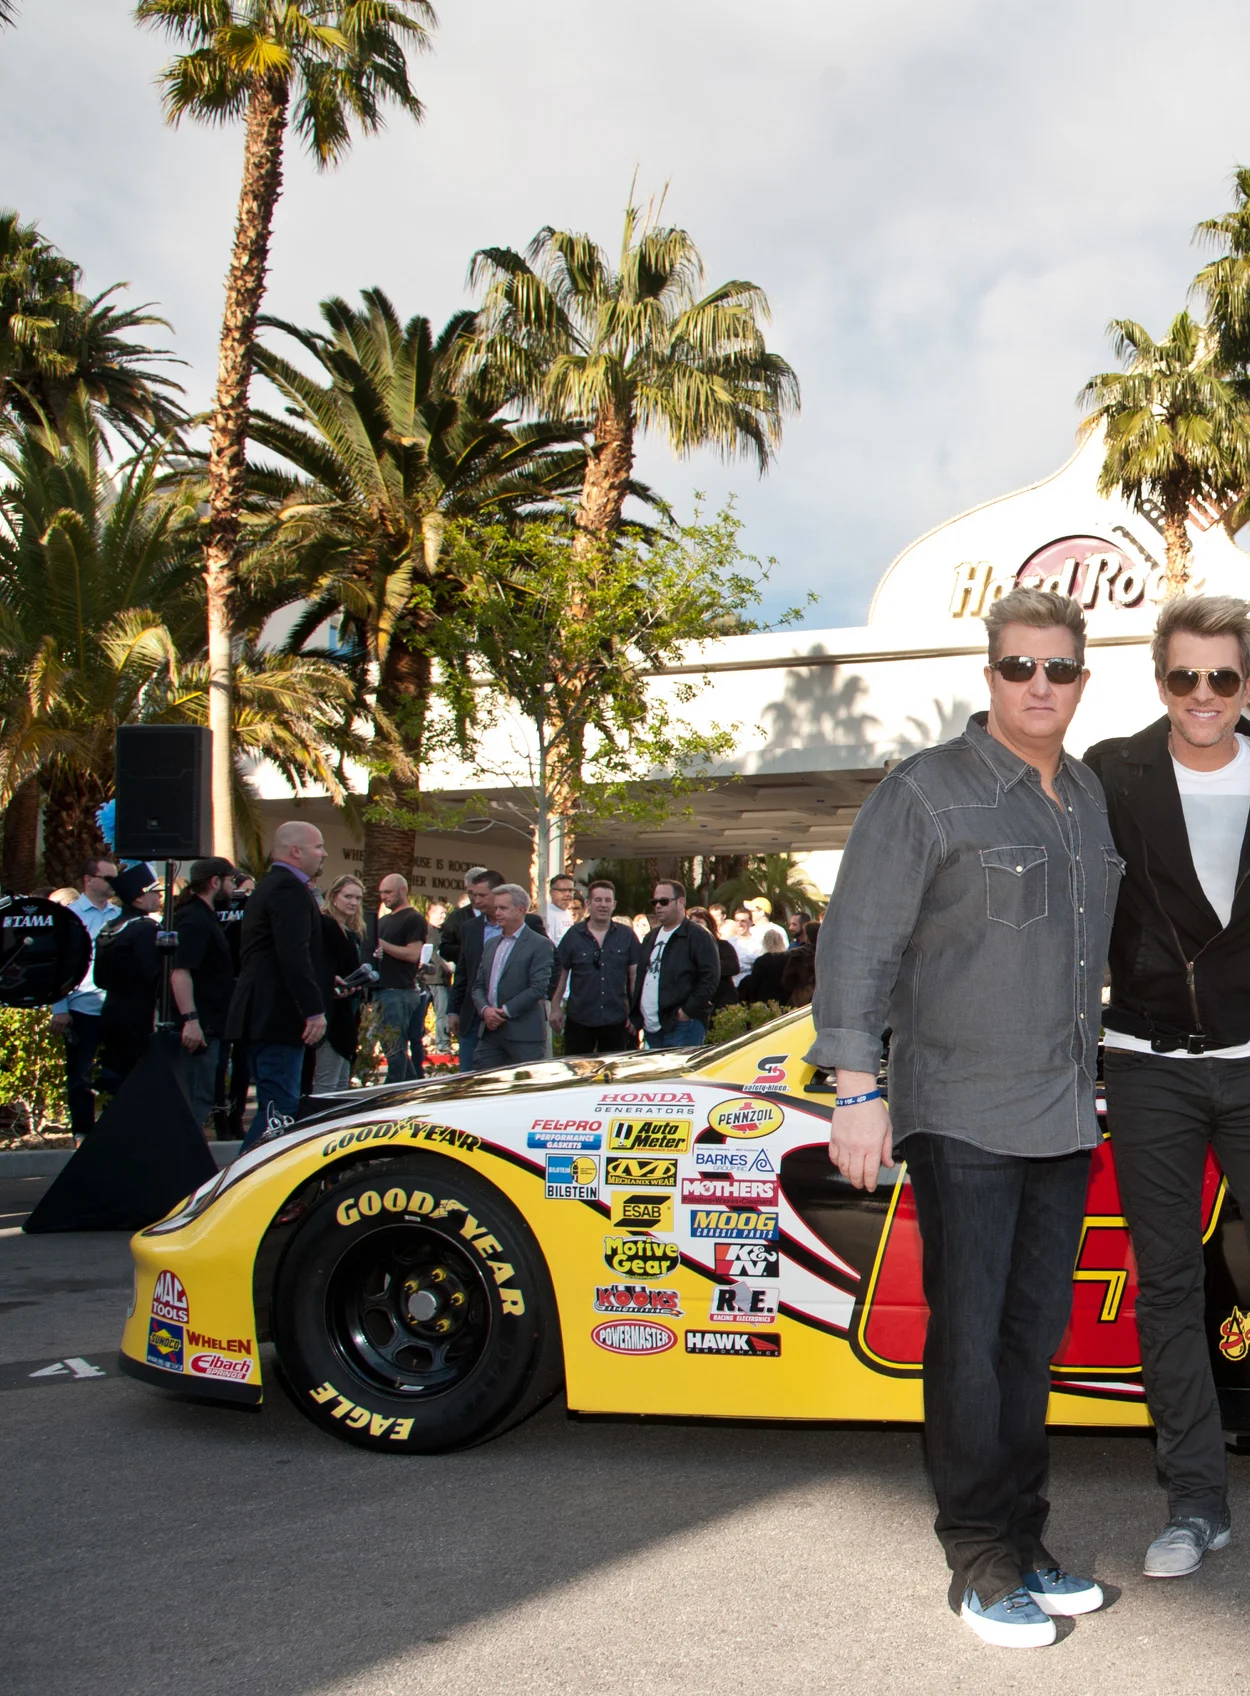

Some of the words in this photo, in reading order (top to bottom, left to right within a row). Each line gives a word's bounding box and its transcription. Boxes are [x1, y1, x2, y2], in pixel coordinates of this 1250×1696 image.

[12, 914, 54, 928] TAMA
[600, 1092, 696, 1103] HONDA
[594, 1106, 695, 1115] GENERATORS
[717, 1108, 774, 1126] PENNZOIL
[531, 1119, 603, 1132] FEL-PRO
[637, 1121, 680, 1135] Auto
[535, 1133, 595, 1142] PERFORMANCE
[634, 1135, 686, 1149] Meter
[546, 1142, 582, 1150] GASKETS
[695, 1153, 748, 1166] BARNES
[607, 1175, 650, 1185] MECHANIX
[650, 1176, 675, 1186] WEAR
[547, 1185, 597, 1198] BILSTEIN
[683, 1179, 774, 1198] MOTHERS
[622, 1205, 661, 1218] ESAB
[693, 1211, 777, 1230] MOOG
[696, 1227, 739, 1238] CHASSIS
[742, 1229, 774, 1239] PARTS
[605, 1237, 679, 1257] Motive
[612, 1254, 670, 1275] Gear
[154, 1271, 188, 1309] MAC
[596, 1287, 679, 1310] KOOKS
[152, 1301, 188, 1323] TOOLS
[736, 1315, 771, 1323] ELECTRONICS
[150, 1333, 181, 1351] SUNOCO
[185, 1328, 252, 1354] WHELEN
[599, 1325, 669, 1349] POWERMASTER
[686, 1332, 750, 1351] HAWK
[191, 1354, 250, 1375] Eibach
[206, 1368, 243, 1379] SPRINGS
[309, 1381, 415, 1440] EAGLE
